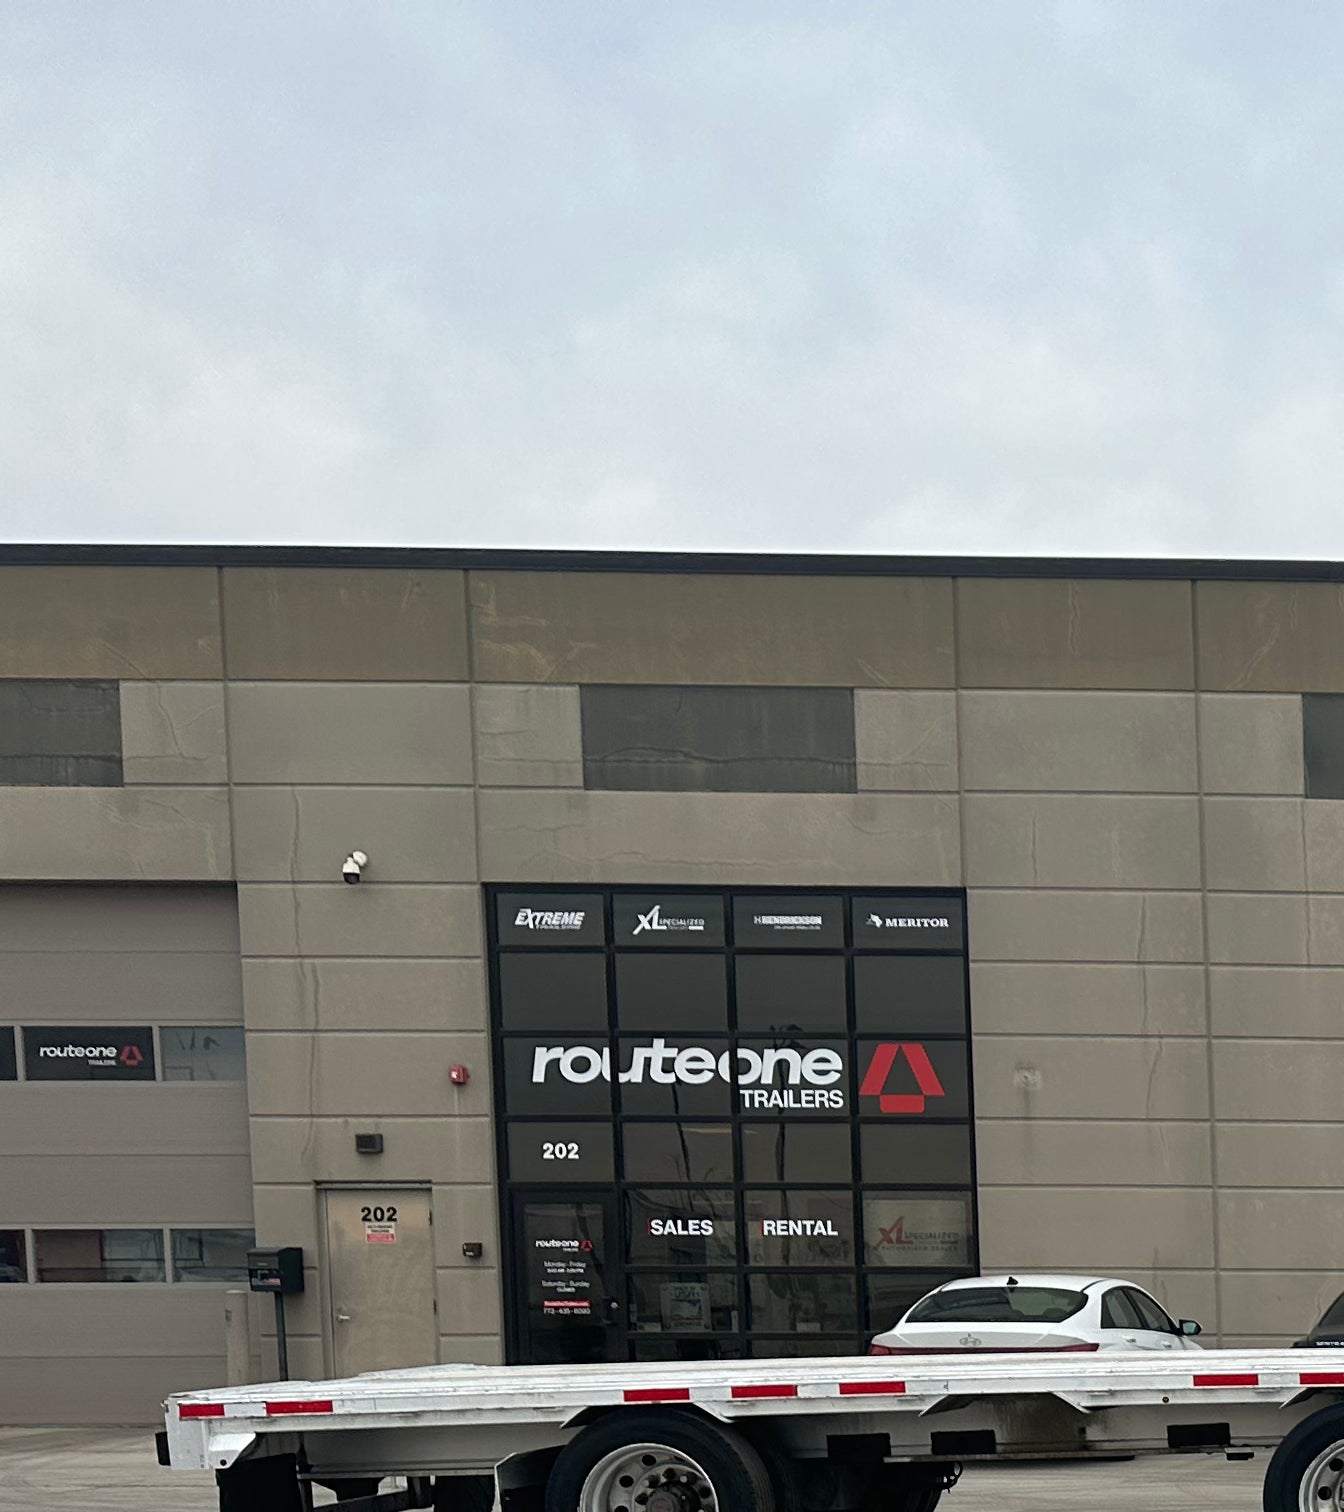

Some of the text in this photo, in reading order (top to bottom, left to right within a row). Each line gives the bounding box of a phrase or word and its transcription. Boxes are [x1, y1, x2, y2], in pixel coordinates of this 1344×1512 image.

[515, 908, 585, 929] EXTREME
[632, 905, 667, 935] XL
[885, 918, 949, 928] MERITOR
[40, 1044, 117, 1057] routeone
[532, 1038, 843, 1085] routeone
[740, 1089, 844, 1109] TRAILERS
[542, 1142, 580, 1160] 202
[361, 1206, 397, 1222] 202
[650, 1219, 714, 1236] SALES
[763, 1219, 839, 1236] RENTAL
